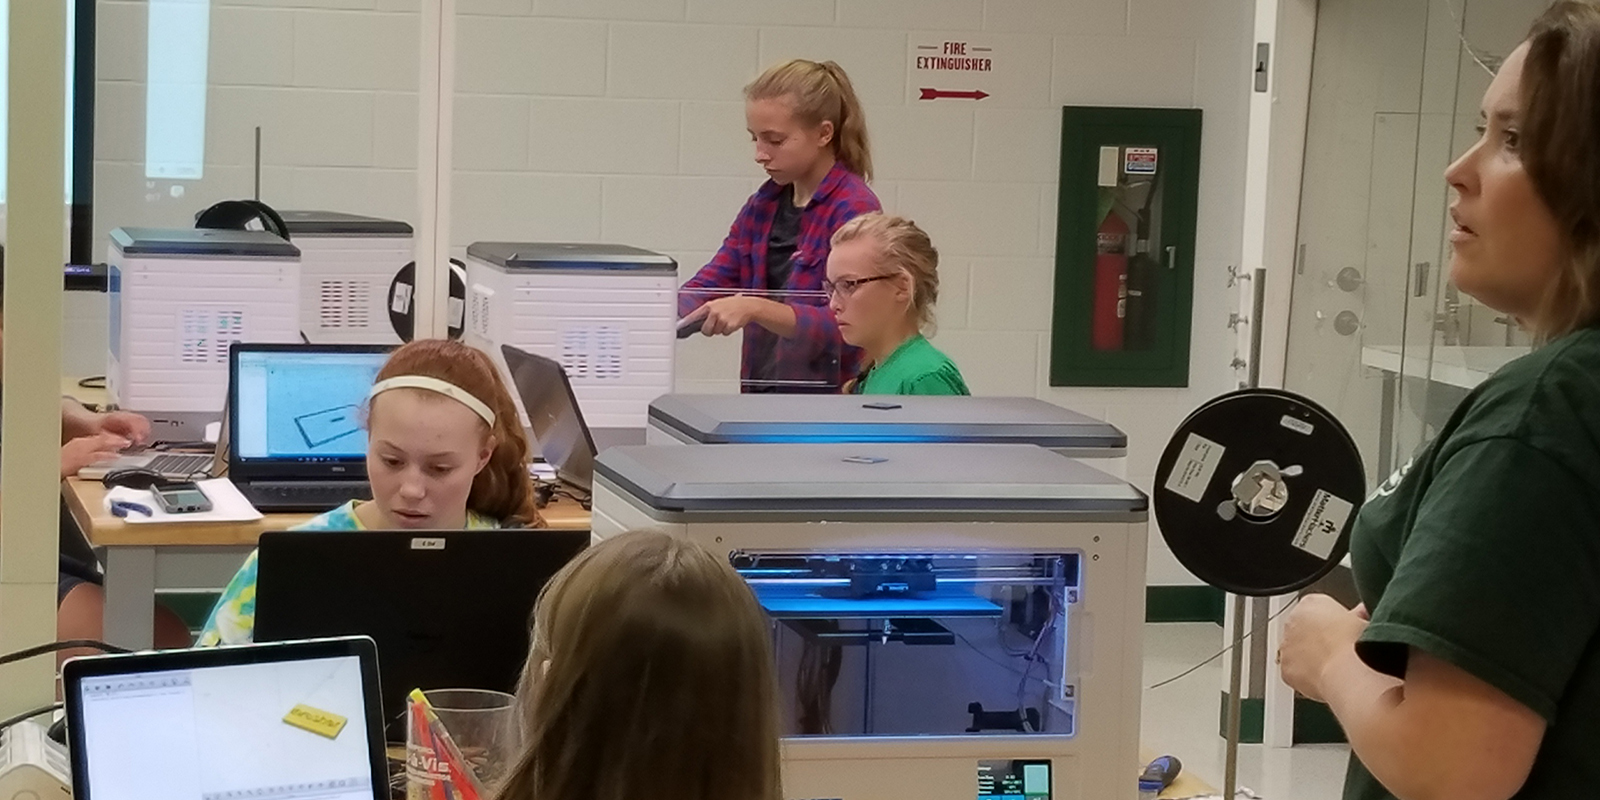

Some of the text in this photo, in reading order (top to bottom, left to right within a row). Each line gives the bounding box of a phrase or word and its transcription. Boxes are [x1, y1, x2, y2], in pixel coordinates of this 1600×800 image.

[944, 42, 967, 55] FIRE
[917, 56, 992, 71] EXTINGUISHER
[1300, 493, 1330, 547] MatterHackers
